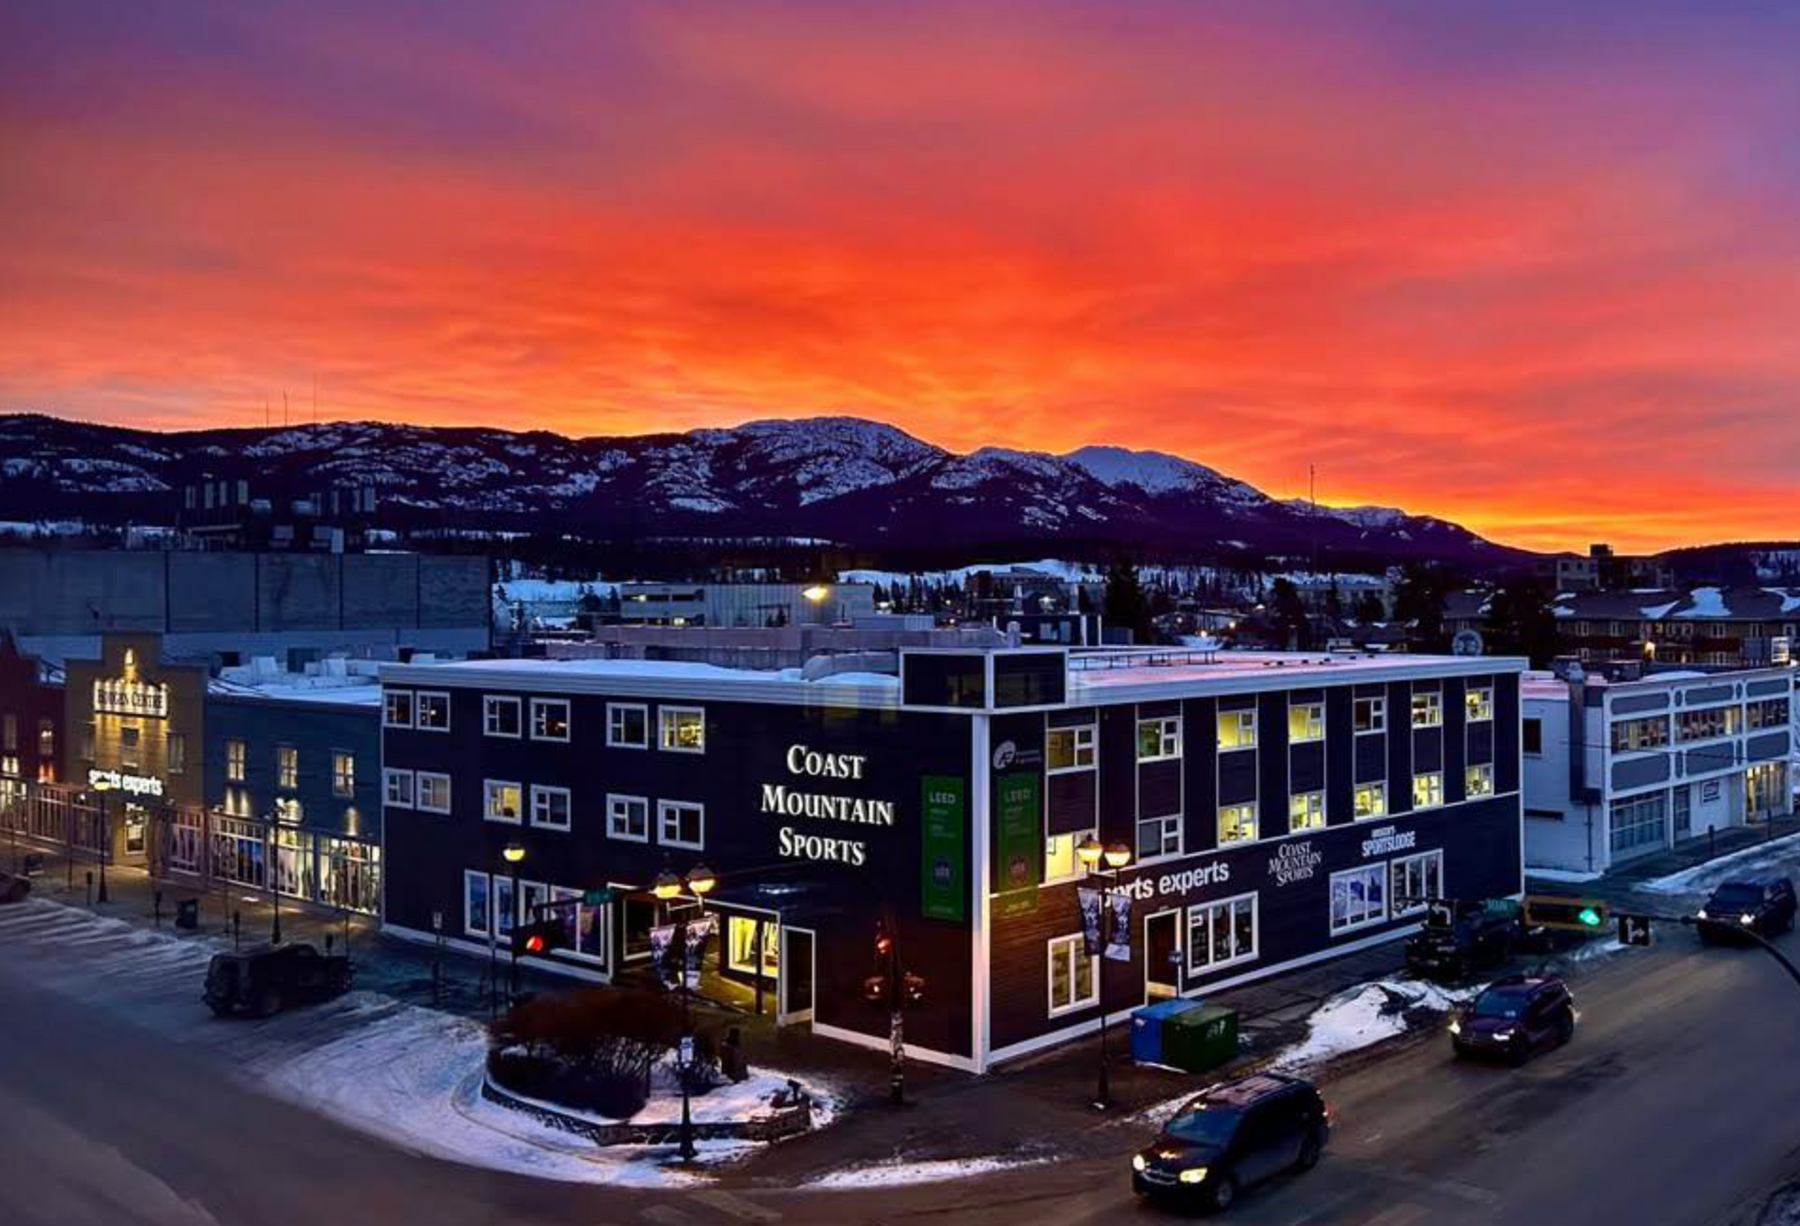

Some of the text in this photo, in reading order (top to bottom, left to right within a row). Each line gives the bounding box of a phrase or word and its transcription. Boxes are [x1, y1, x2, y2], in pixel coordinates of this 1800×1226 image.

[787, 744, 866, 779] COAST
[122, 775, 162, 796] experts
[761, 783, 894, 825] MOUNTAIN
[928, 791, 957, 805] LEED
[779, 826, 866, 866] SPORTS
[1278, 840, 1312, 858] COAST
[1268, 851, 1322, 875] MOUNTAIN
[1099, 860, 1230, 914] ports experts
[1275, 868, 1314, 887] SPORTS
